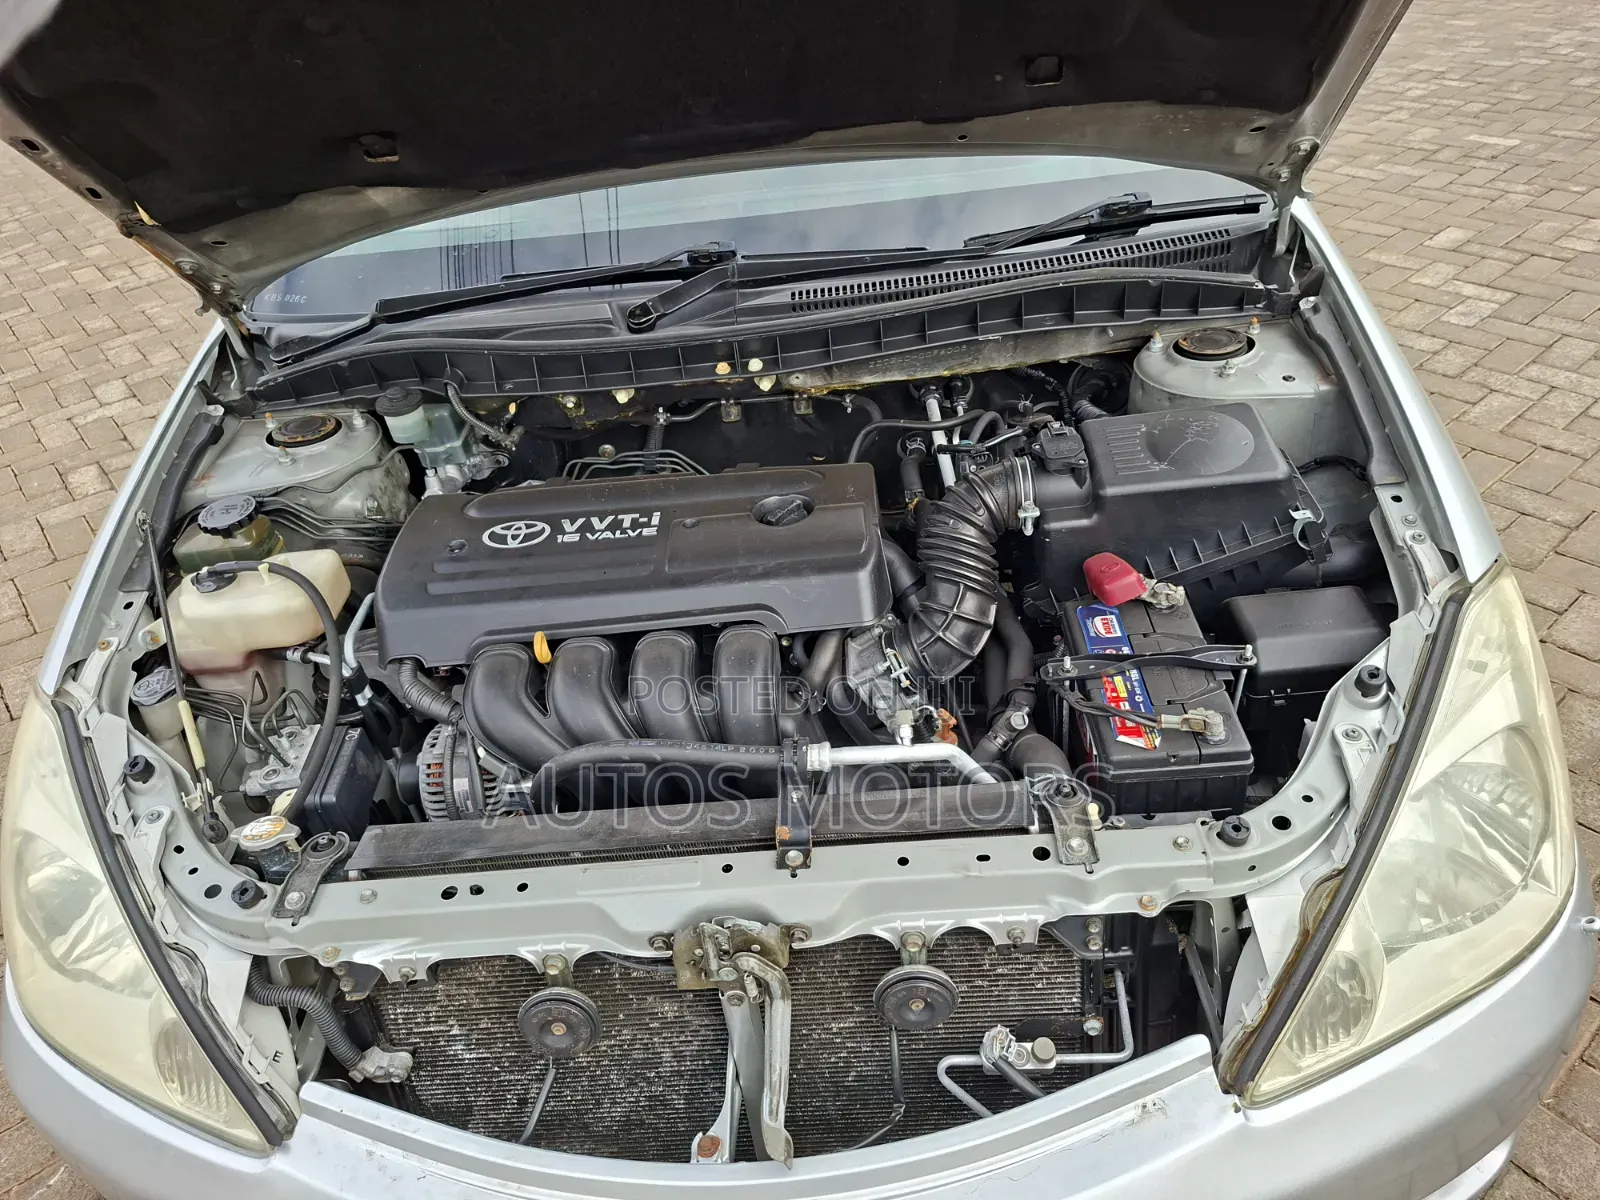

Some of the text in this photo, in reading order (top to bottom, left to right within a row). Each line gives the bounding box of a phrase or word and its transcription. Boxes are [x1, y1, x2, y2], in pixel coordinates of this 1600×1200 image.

[560, 511, 661, 533] VVT-i
[556, 527, 658, 543] 16 VALVE
[1100, 617, 1114, 636] EXIDE
